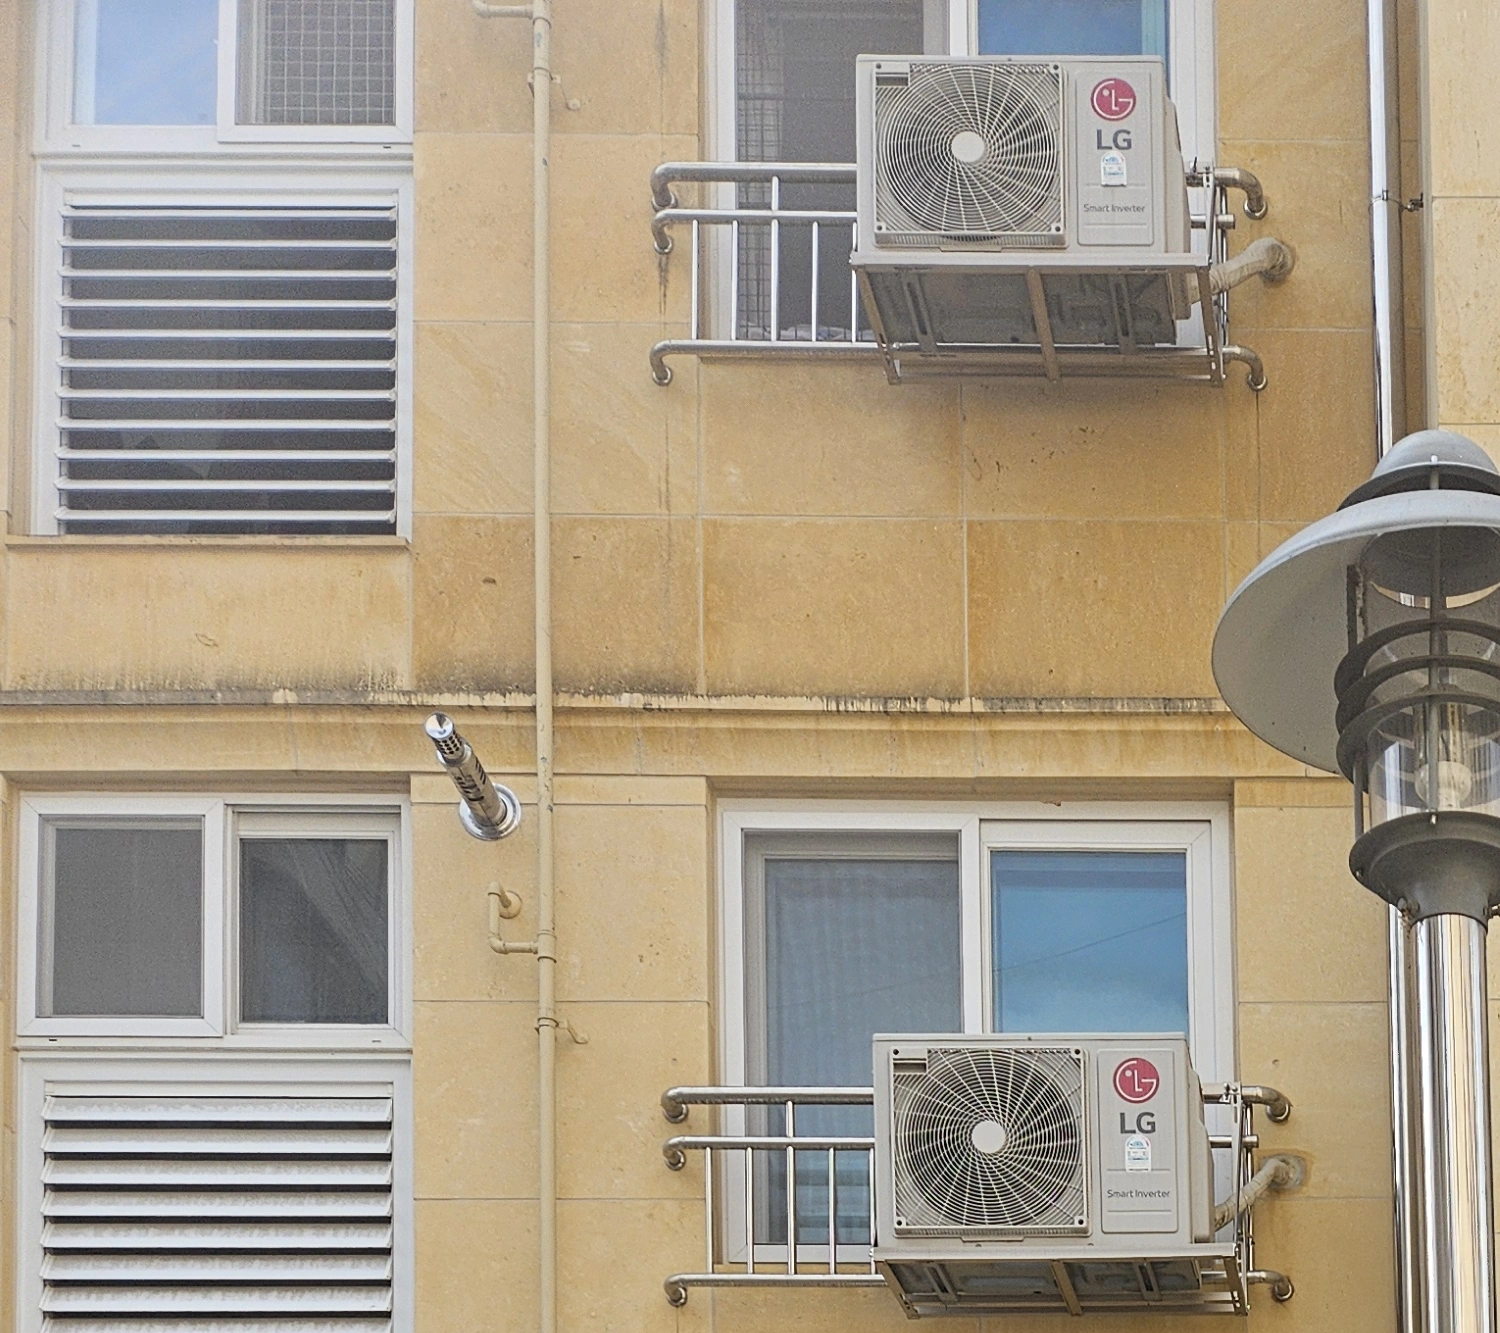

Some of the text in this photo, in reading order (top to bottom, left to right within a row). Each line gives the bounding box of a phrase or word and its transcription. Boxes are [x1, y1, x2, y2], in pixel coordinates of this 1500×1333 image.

[1096, 128, 1132, 151] LG
[1083, 203, 1146, 213] Smart Inverter
[1119, 1111, 1156, 1135] LG
[1106, 1188, 1171, 1199] Smart Inverter
